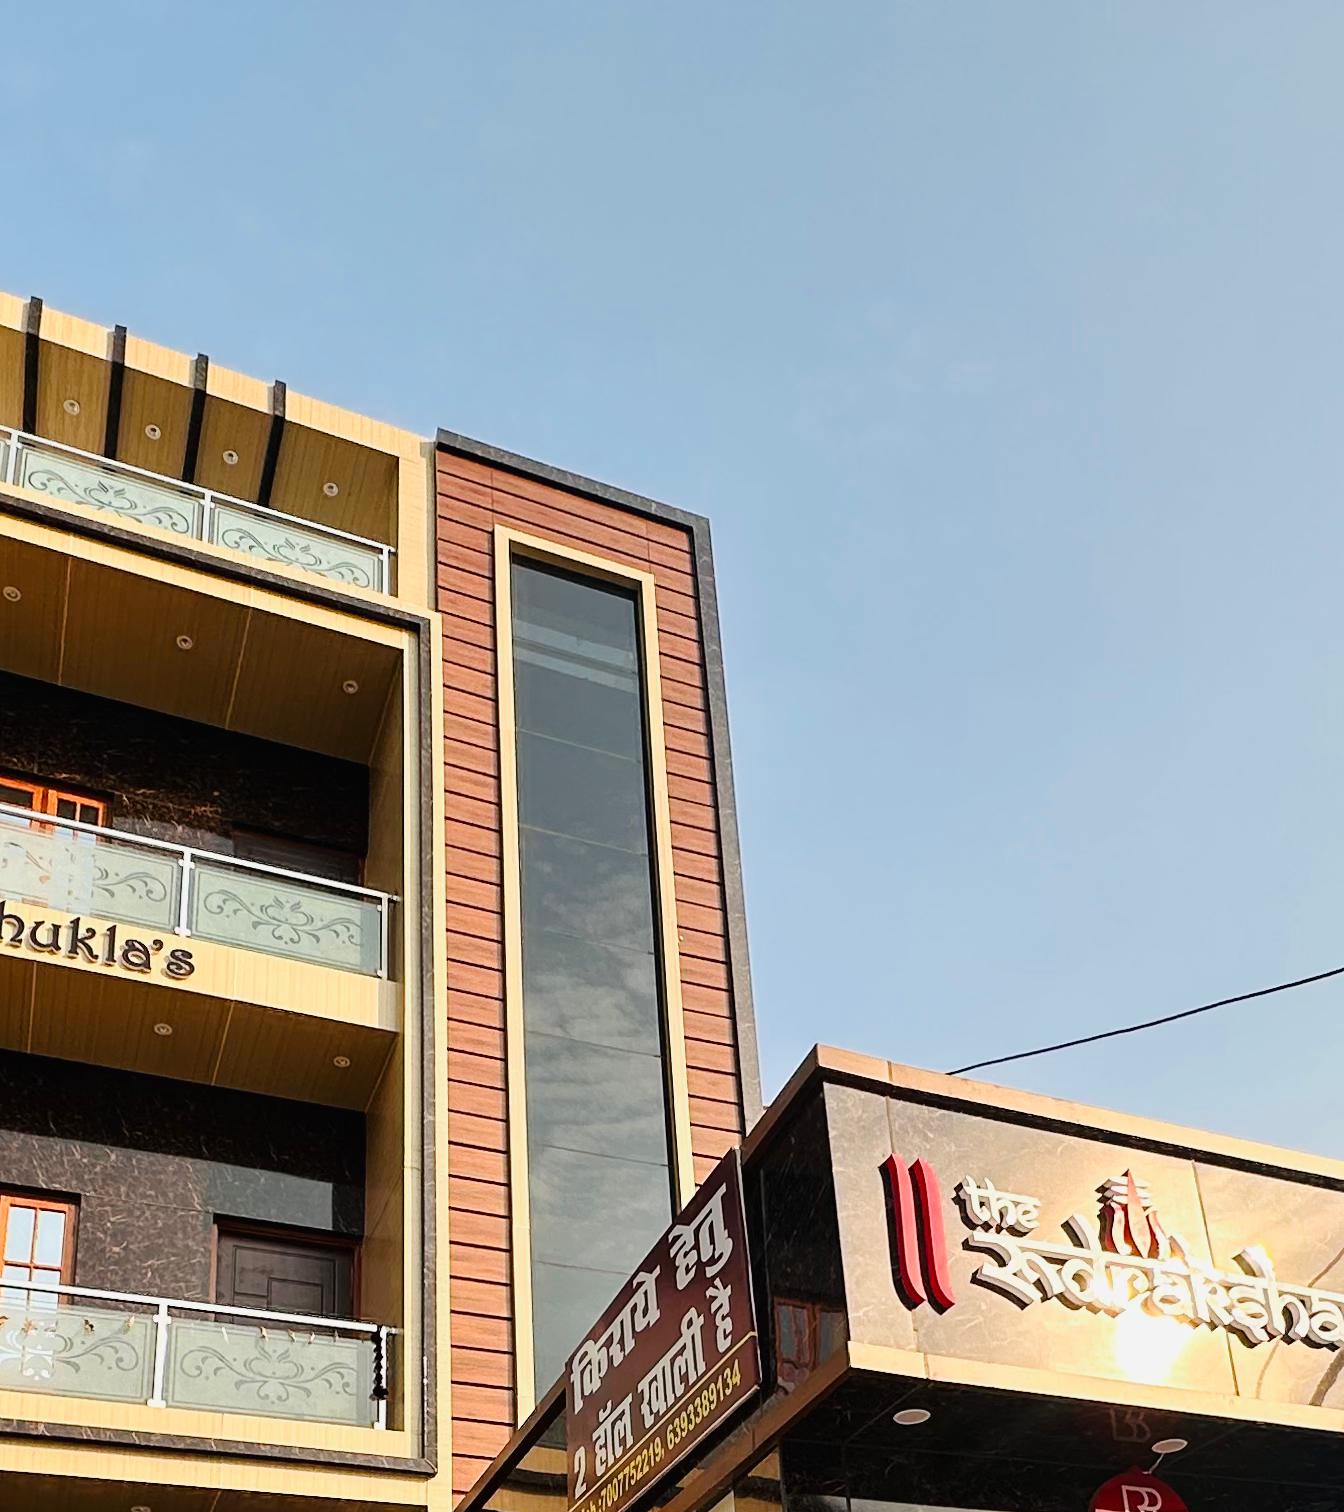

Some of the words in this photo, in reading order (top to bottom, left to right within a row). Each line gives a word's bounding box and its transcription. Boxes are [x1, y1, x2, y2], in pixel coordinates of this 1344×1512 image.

[954, 1174, 1041, 1233] the
[570, 1264, 661, 1414] किराये
[668, 1183, 734, 1291] हेतु
[574, 1445, 586, 1500] 2
[592, 1401, 634, 1478] हॉल
[637, 1306, 706, 1428] खाली
[705, 1277, 733, 1355] है
[666, 1359, 742, 1451] 6393389134
